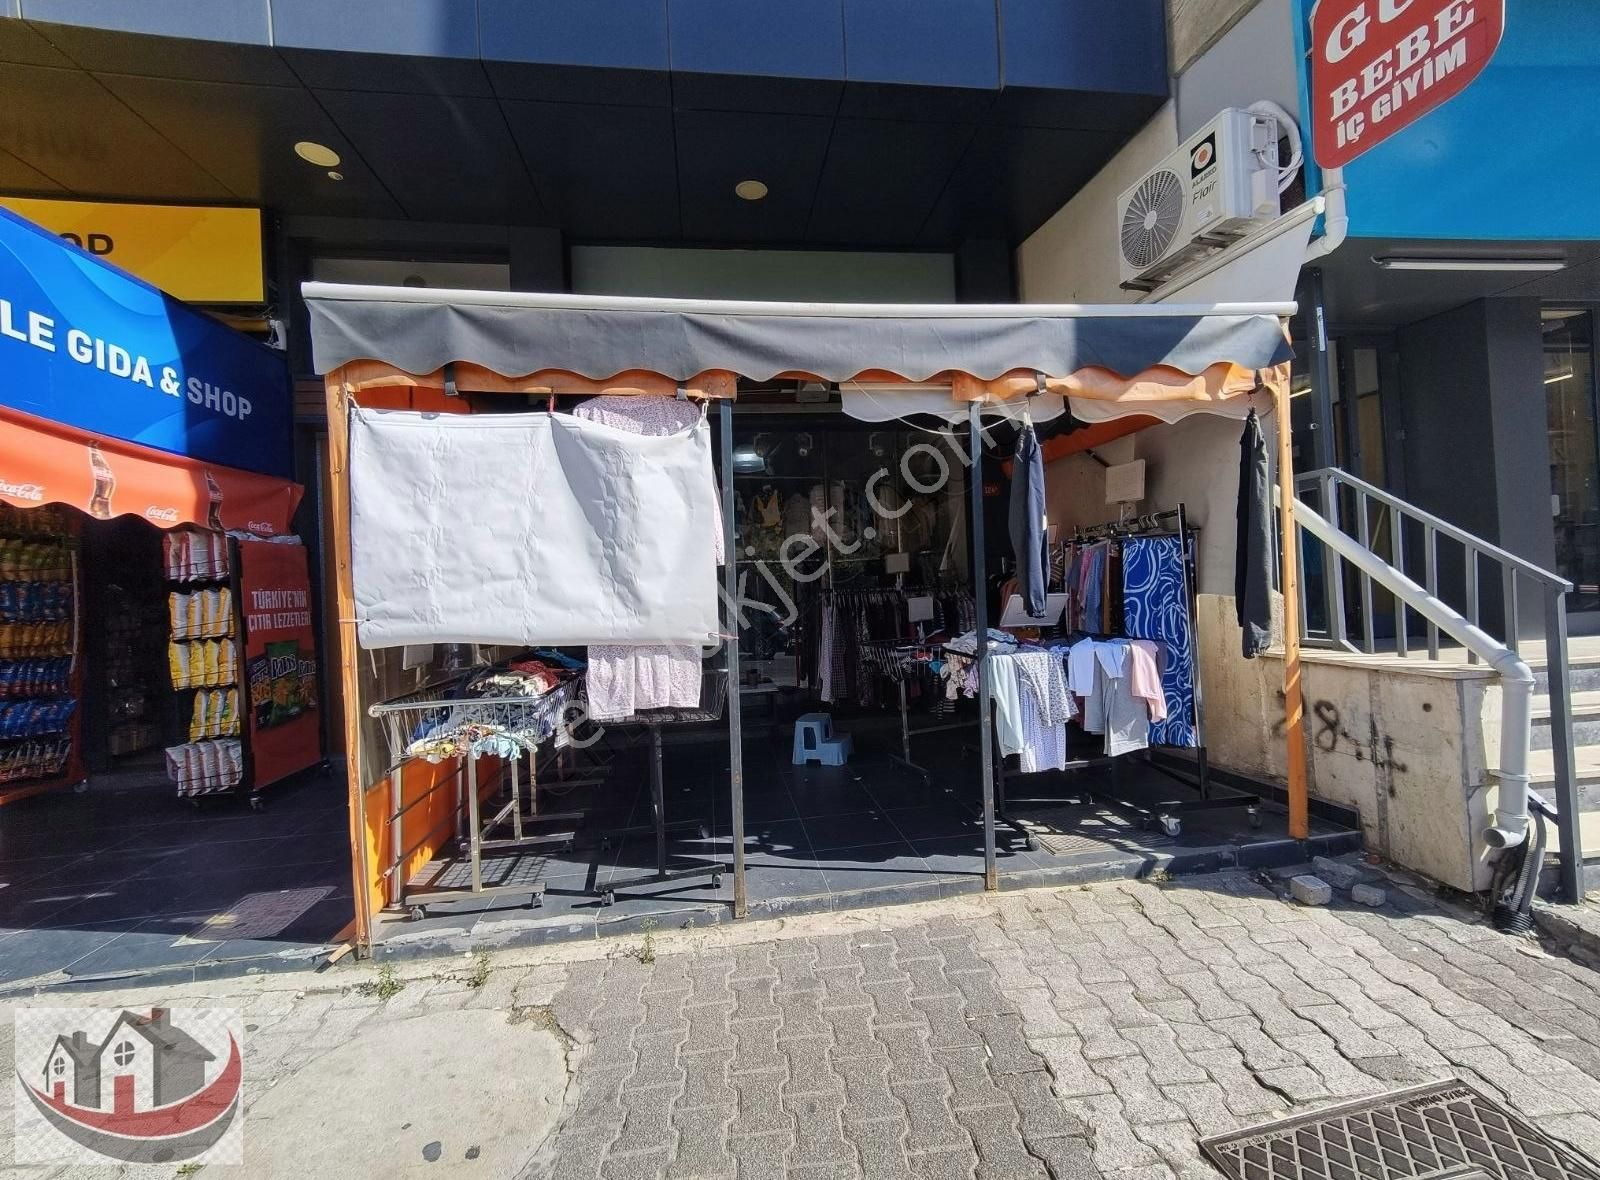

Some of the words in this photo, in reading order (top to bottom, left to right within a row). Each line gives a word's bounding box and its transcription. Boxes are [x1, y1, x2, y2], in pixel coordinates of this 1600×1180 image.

[1330, 0, 1474, 122] BEBE
[1337, 112, 1365, 148] İÇ
[1371, 37, 1467, 124] GİYİM
[1193, 180, 1217, 205] Flair
[67, 329, 154, 388] GIDA
[159, 366, 181, 398] &
[187, 376, 252, 420] SHOP
